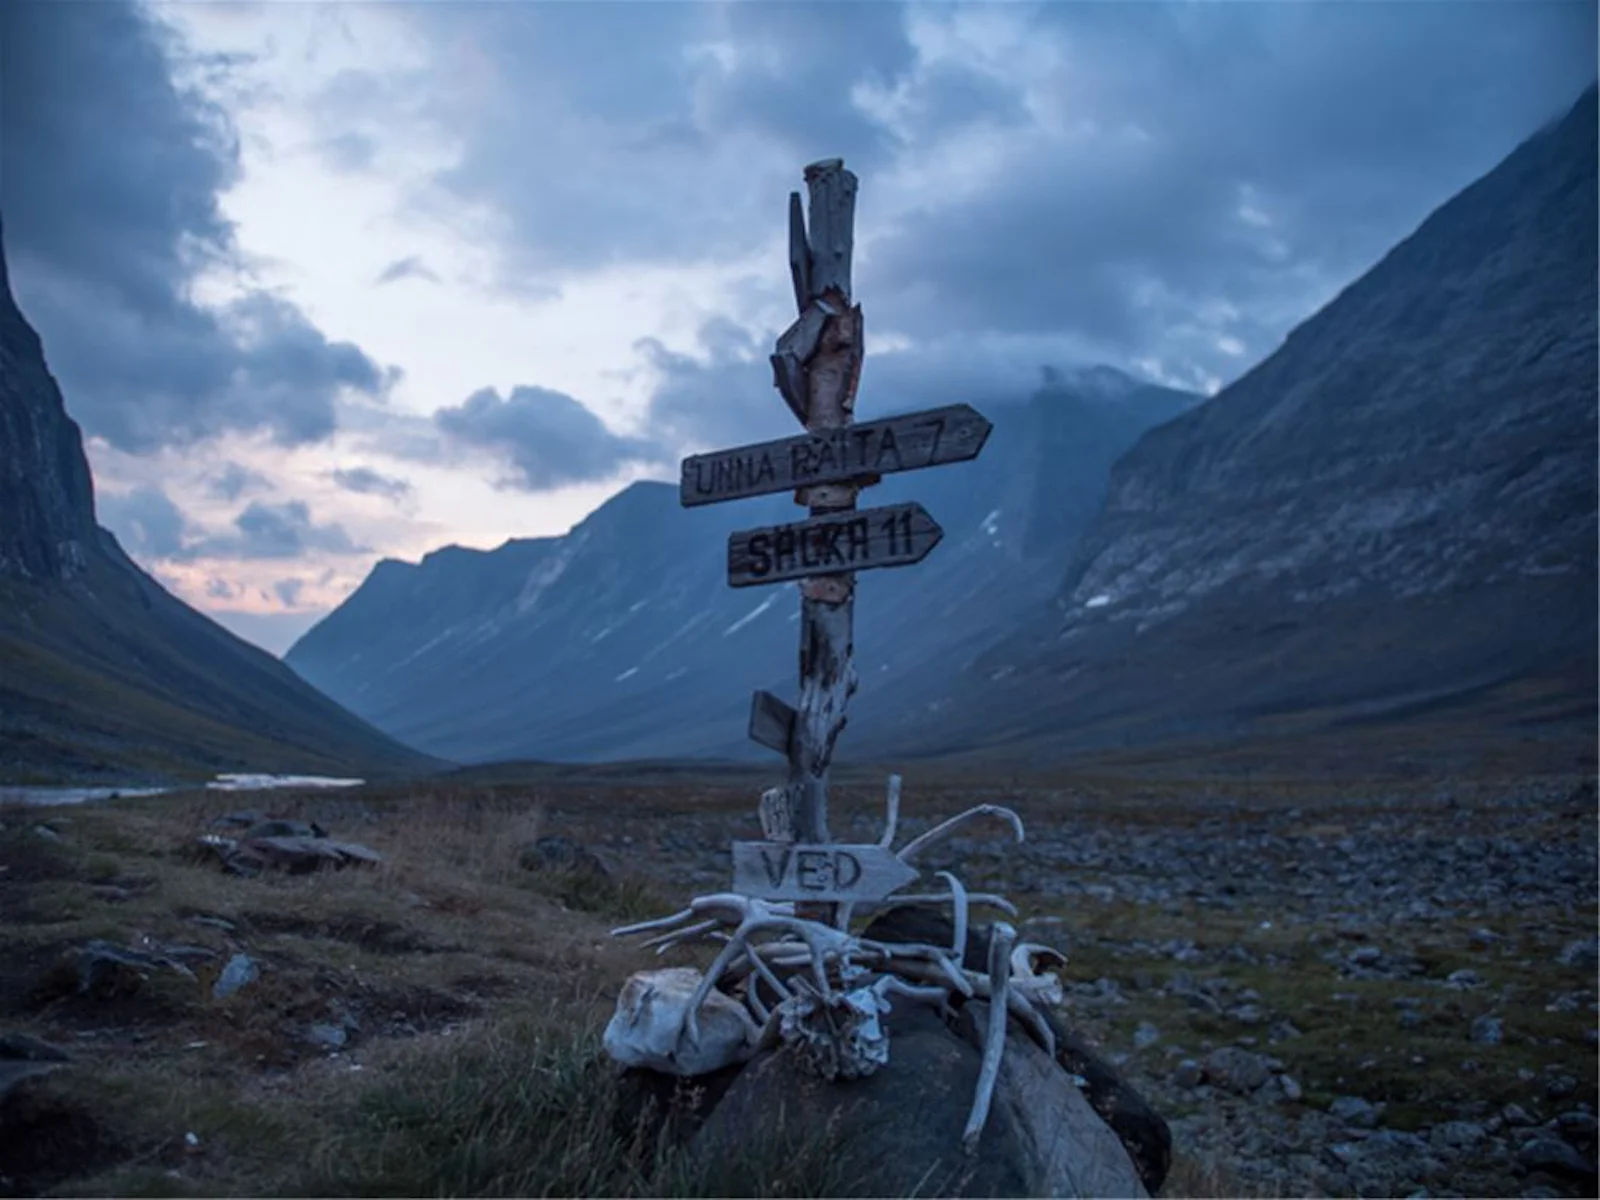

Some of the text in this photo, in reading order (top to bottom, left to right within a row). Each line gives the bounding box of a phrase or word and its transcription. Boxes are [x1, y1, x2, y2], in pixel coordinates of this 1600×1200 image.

[695, 453, 776, 495] UNNA
[915, 420, 945, 463] 7
[881, 510, 911, 556] 11
[761, 850, 862, 891] VED
